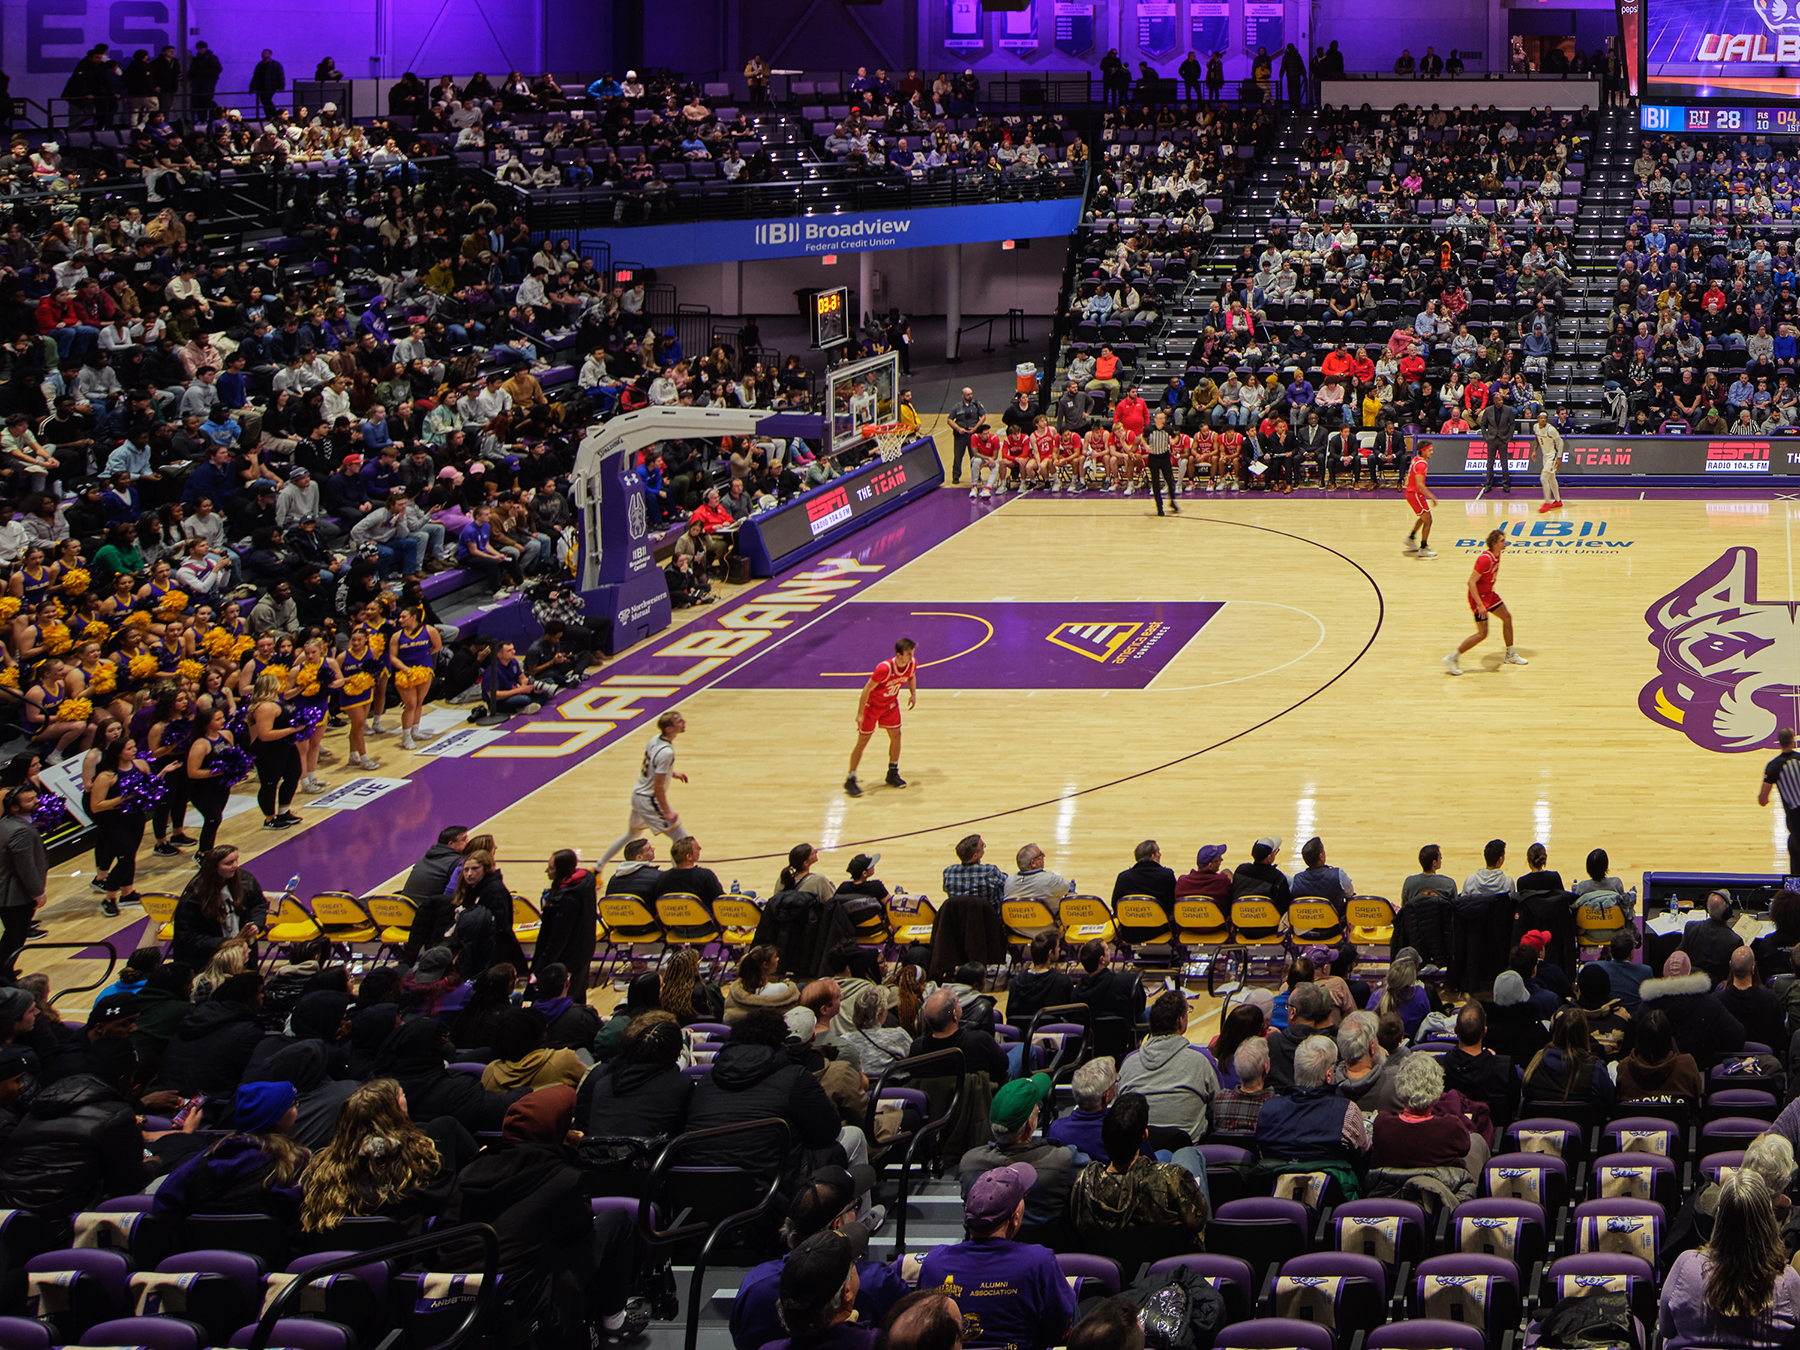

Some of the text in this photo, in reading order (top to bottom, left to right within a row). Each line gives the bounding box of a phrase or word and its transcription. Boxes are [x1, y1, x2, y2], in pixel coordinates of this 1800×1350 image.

[1621, 4, 1638, 16] pepsi
[1716, 110, 1741, 129] 28
[1756, 120, 1769, 130] 10
[1787, 124, 1800, 132] 1ST
[805, 219, 910, 240] Broadview
[805, 238, 896, 252] Federal Credit Union
[597, 436, 624, 458] SPALDING
[1574, 447, 1632, 465] TEAM
[1706, 442, 1770, 460] ESPN
[1707, 462, 1767, 470] RADIO 104.5 FM
[856, 464, 907, 502] THE TEAM
[805, 486, 849, 523] ESPN
[812, 507, 851, 532] RADIO 104.5 FM
[631, 592, 667, 613] Northwestern
[631, 605, 651, 622] Mutual
[1133, 625, 1171, 659] CONFERENCE
[470, 557, 887, 758] UALBANY
[883, 684, 901, 697] 30
[969, 1288, 1018, 1297] ASSOCIATION
[980, 1281, 1008, 1289] ALUMNI
